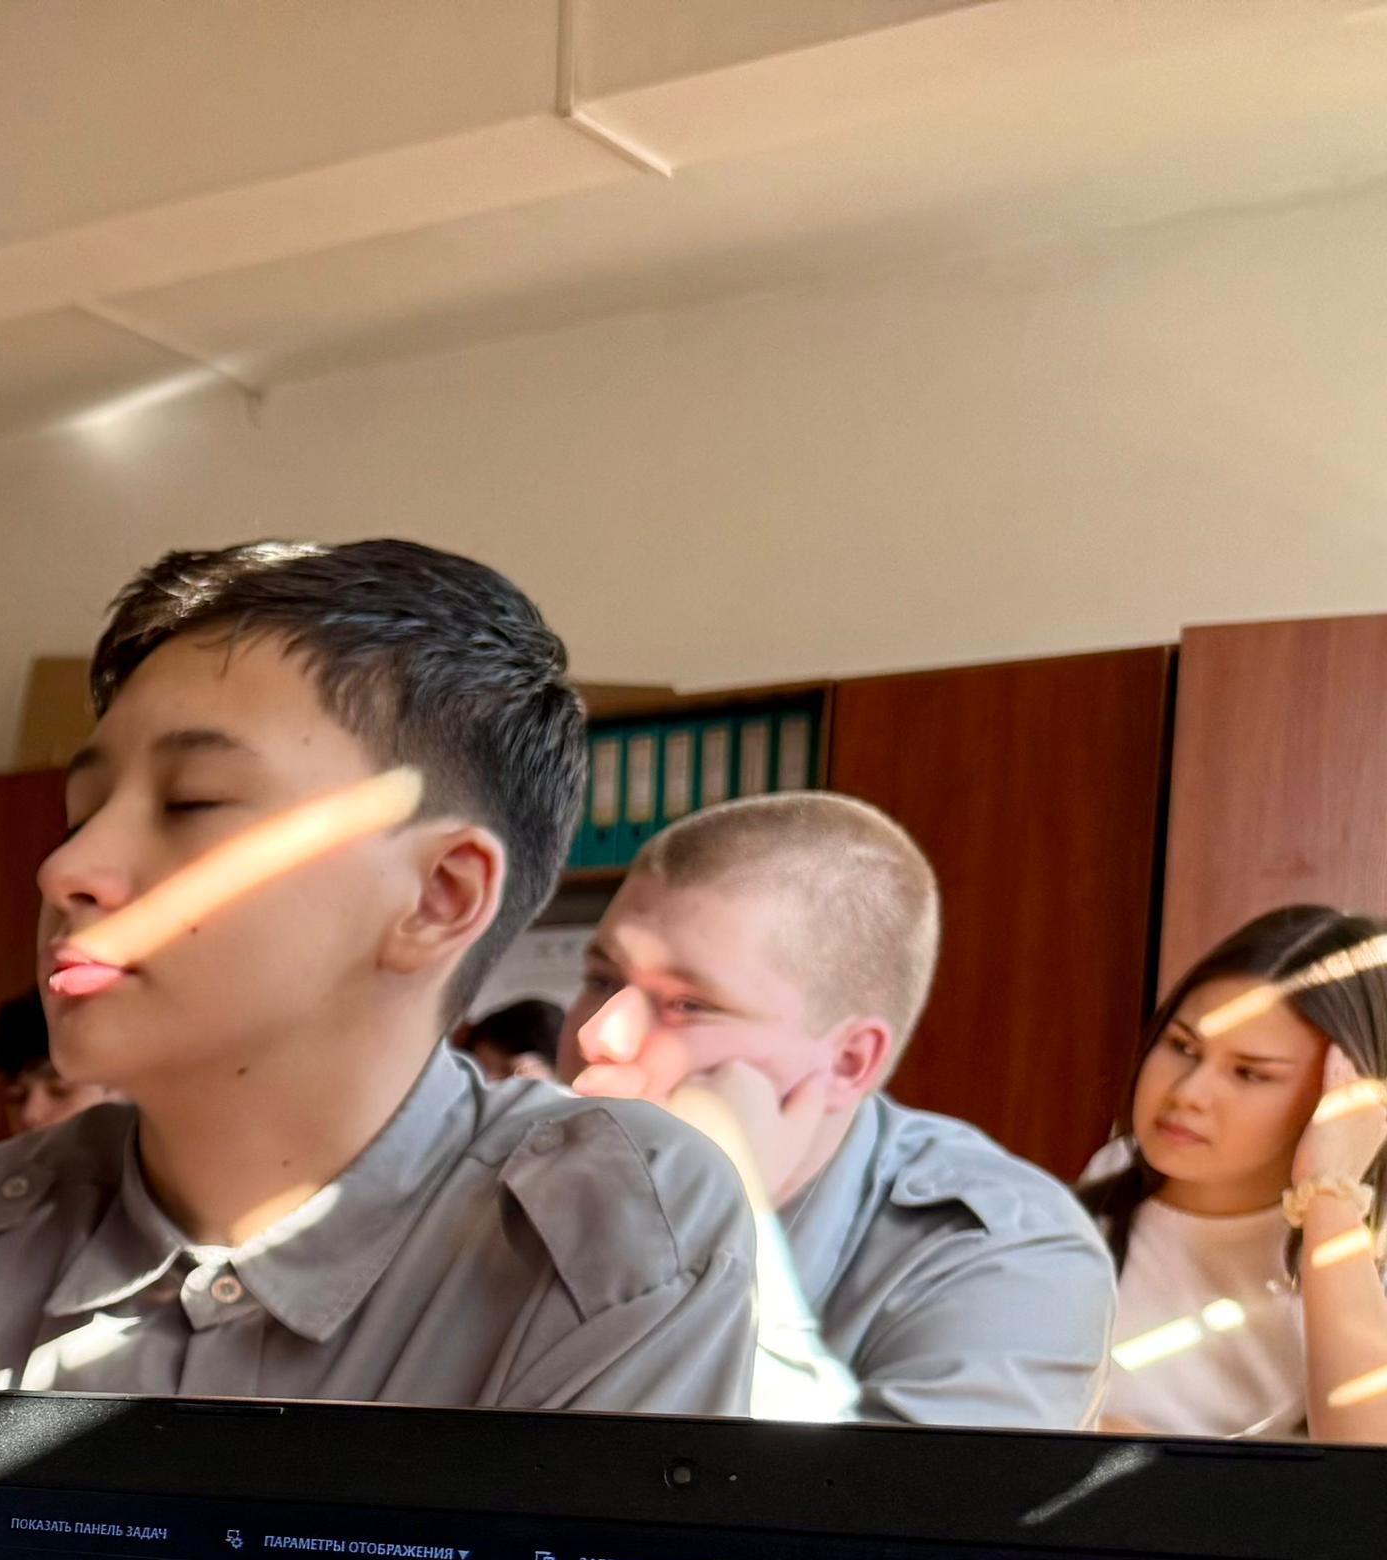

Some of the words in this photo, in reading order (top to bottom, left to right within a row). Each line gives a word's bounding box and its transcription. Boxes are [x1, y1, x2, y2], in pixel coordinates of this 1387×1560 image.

[11, 1518, 72, 1533] ПОКАЗАТЬ
[75, 1522, 123, 1537] ПАНЕЛЬ
[126, 1526, 167, 1541] ЗАДАЧ
[264, 1535, 345, 1553] ПАРАМЕТРЫ
